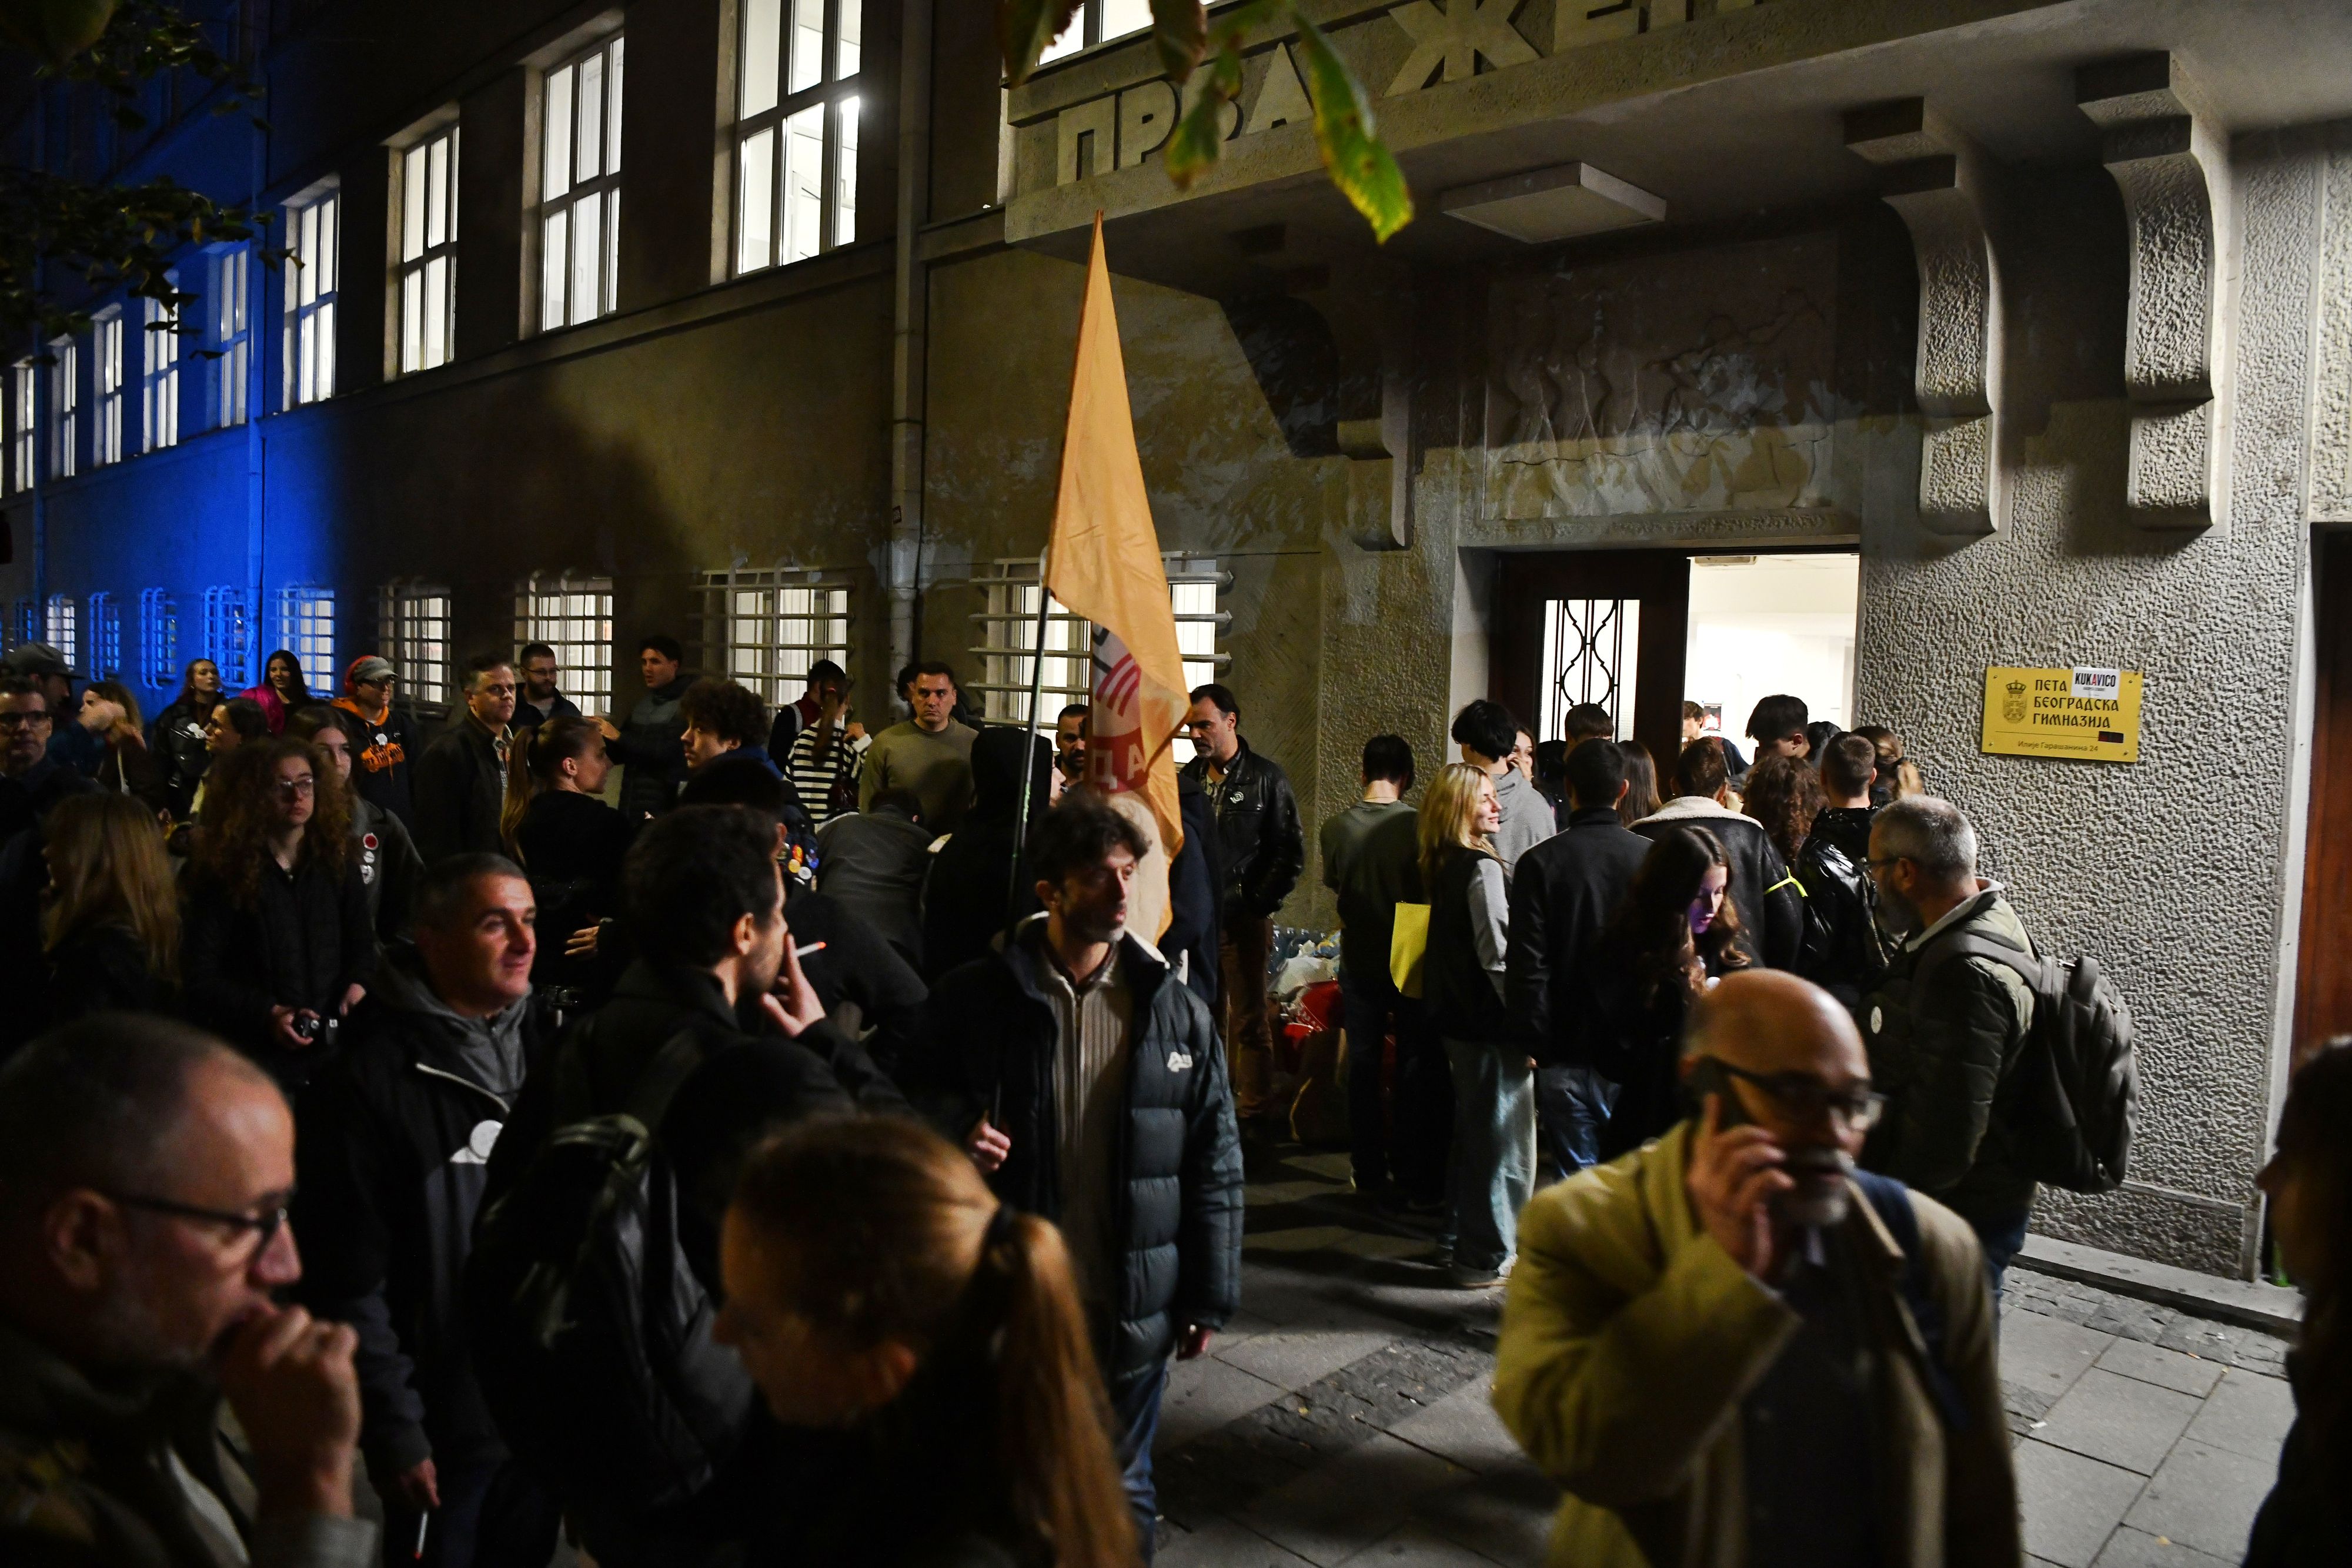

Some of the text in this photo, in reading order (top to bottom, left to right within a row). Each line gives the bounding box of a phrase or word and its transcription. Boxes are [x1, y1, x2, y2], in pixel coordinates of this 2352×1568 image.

[2035, 680, 2067, 692] ПЕТА
[2074, 673, 2116, 687] KUKAVICO
[2034, 696, 2119, 711] БЕОГРАДСКА
[2033, 713, 2111, 728] ГИМНАЗИЈА
[2017, 740, 2040, 750] Илије
[2040, 742, 2087, 751] Гарашанина
